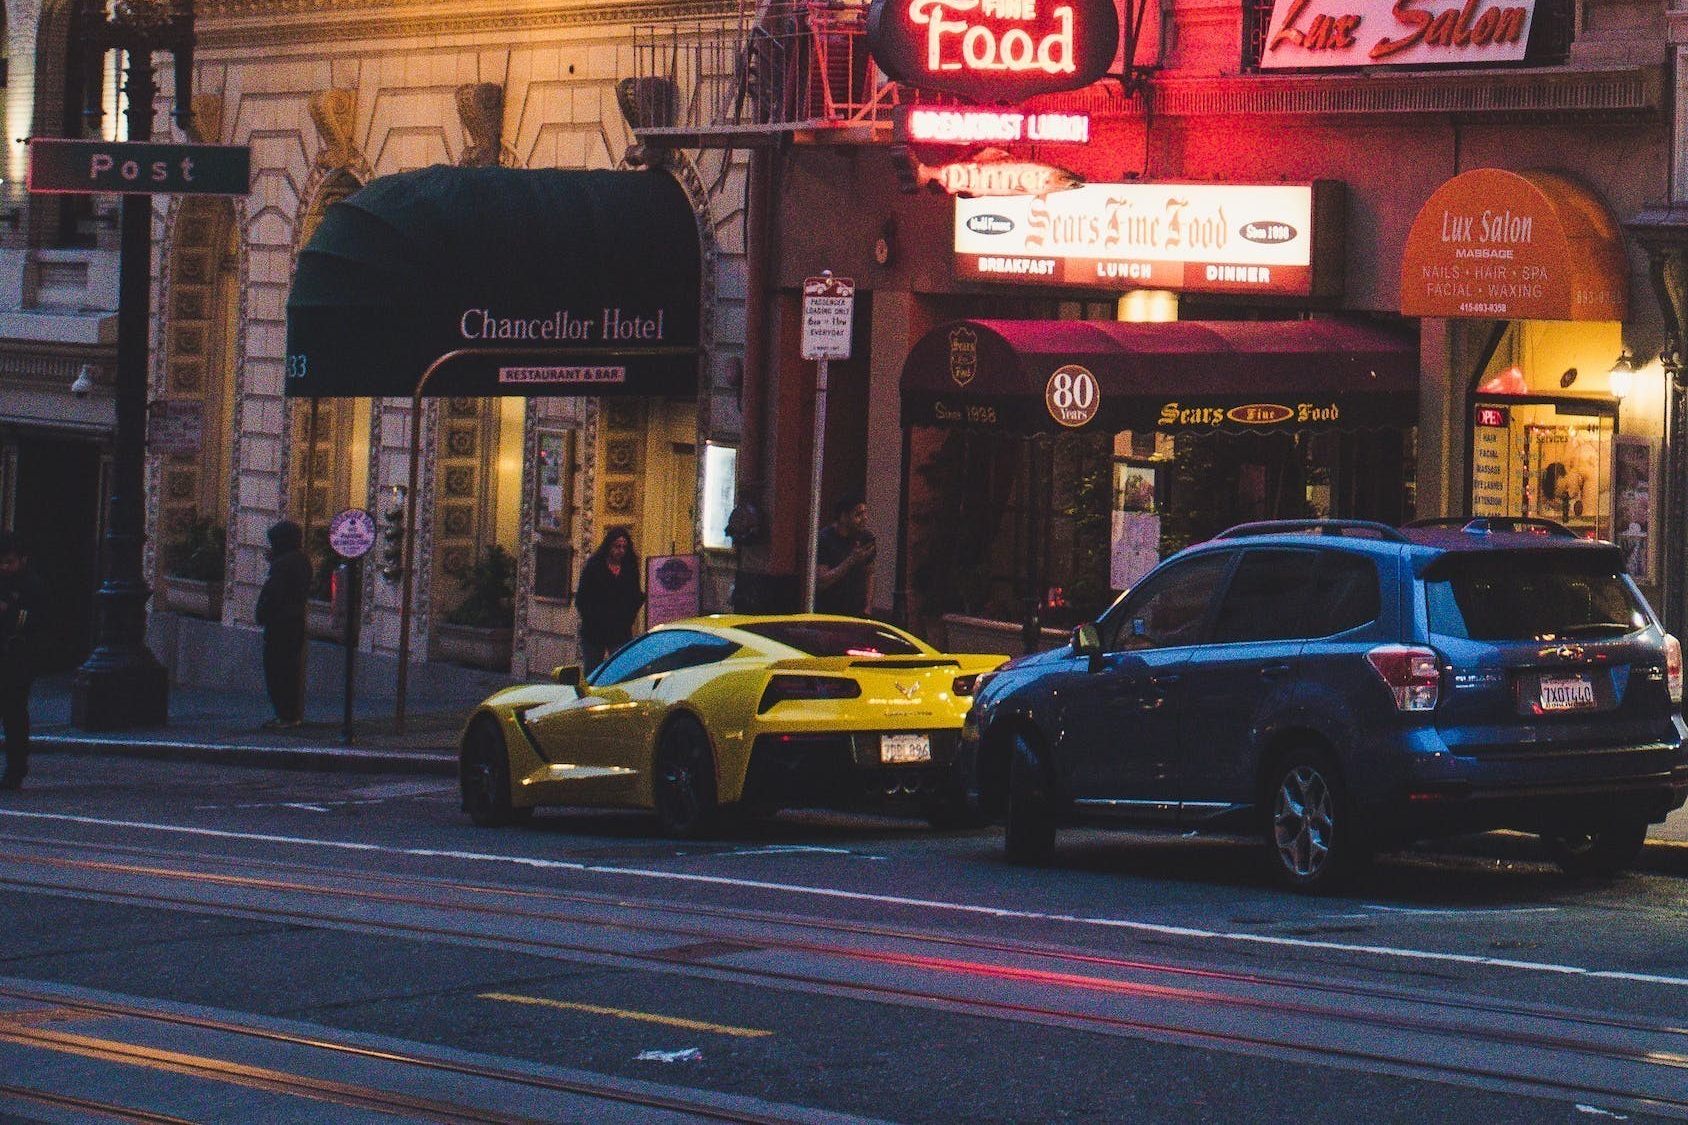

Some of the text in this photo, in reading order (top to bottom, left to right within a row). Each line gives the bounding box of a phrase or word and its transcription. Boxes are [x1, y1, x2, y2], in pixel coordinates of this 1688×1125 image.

[90, 153, 195, 182] Post
[1024, 194, 1229, 251] Sears Fine Food
[1441, 209, 1534, 244] Lux Salon
[1455, 248, 1515, 260] MASSAGE
[977, 257, 1272, 284] BREAKFAST LUNCH DINNER
[1421, 265, 1549, 280] NAILS HAIR SPA
[1426, 282, 1544, 298] FACIAL WAXING
[459, 307, 665, 341] Chancellor Hotel
[506, 369, 580, 379] RESTAURANT
[595, 369, 620, 379] BAR
[1053, 373, 1094, 409] 80
[1060, 407, 1088, 420] Years
[1157, 401, 1225, 427] Sears
[1296, 402, 1340, 422] Food
